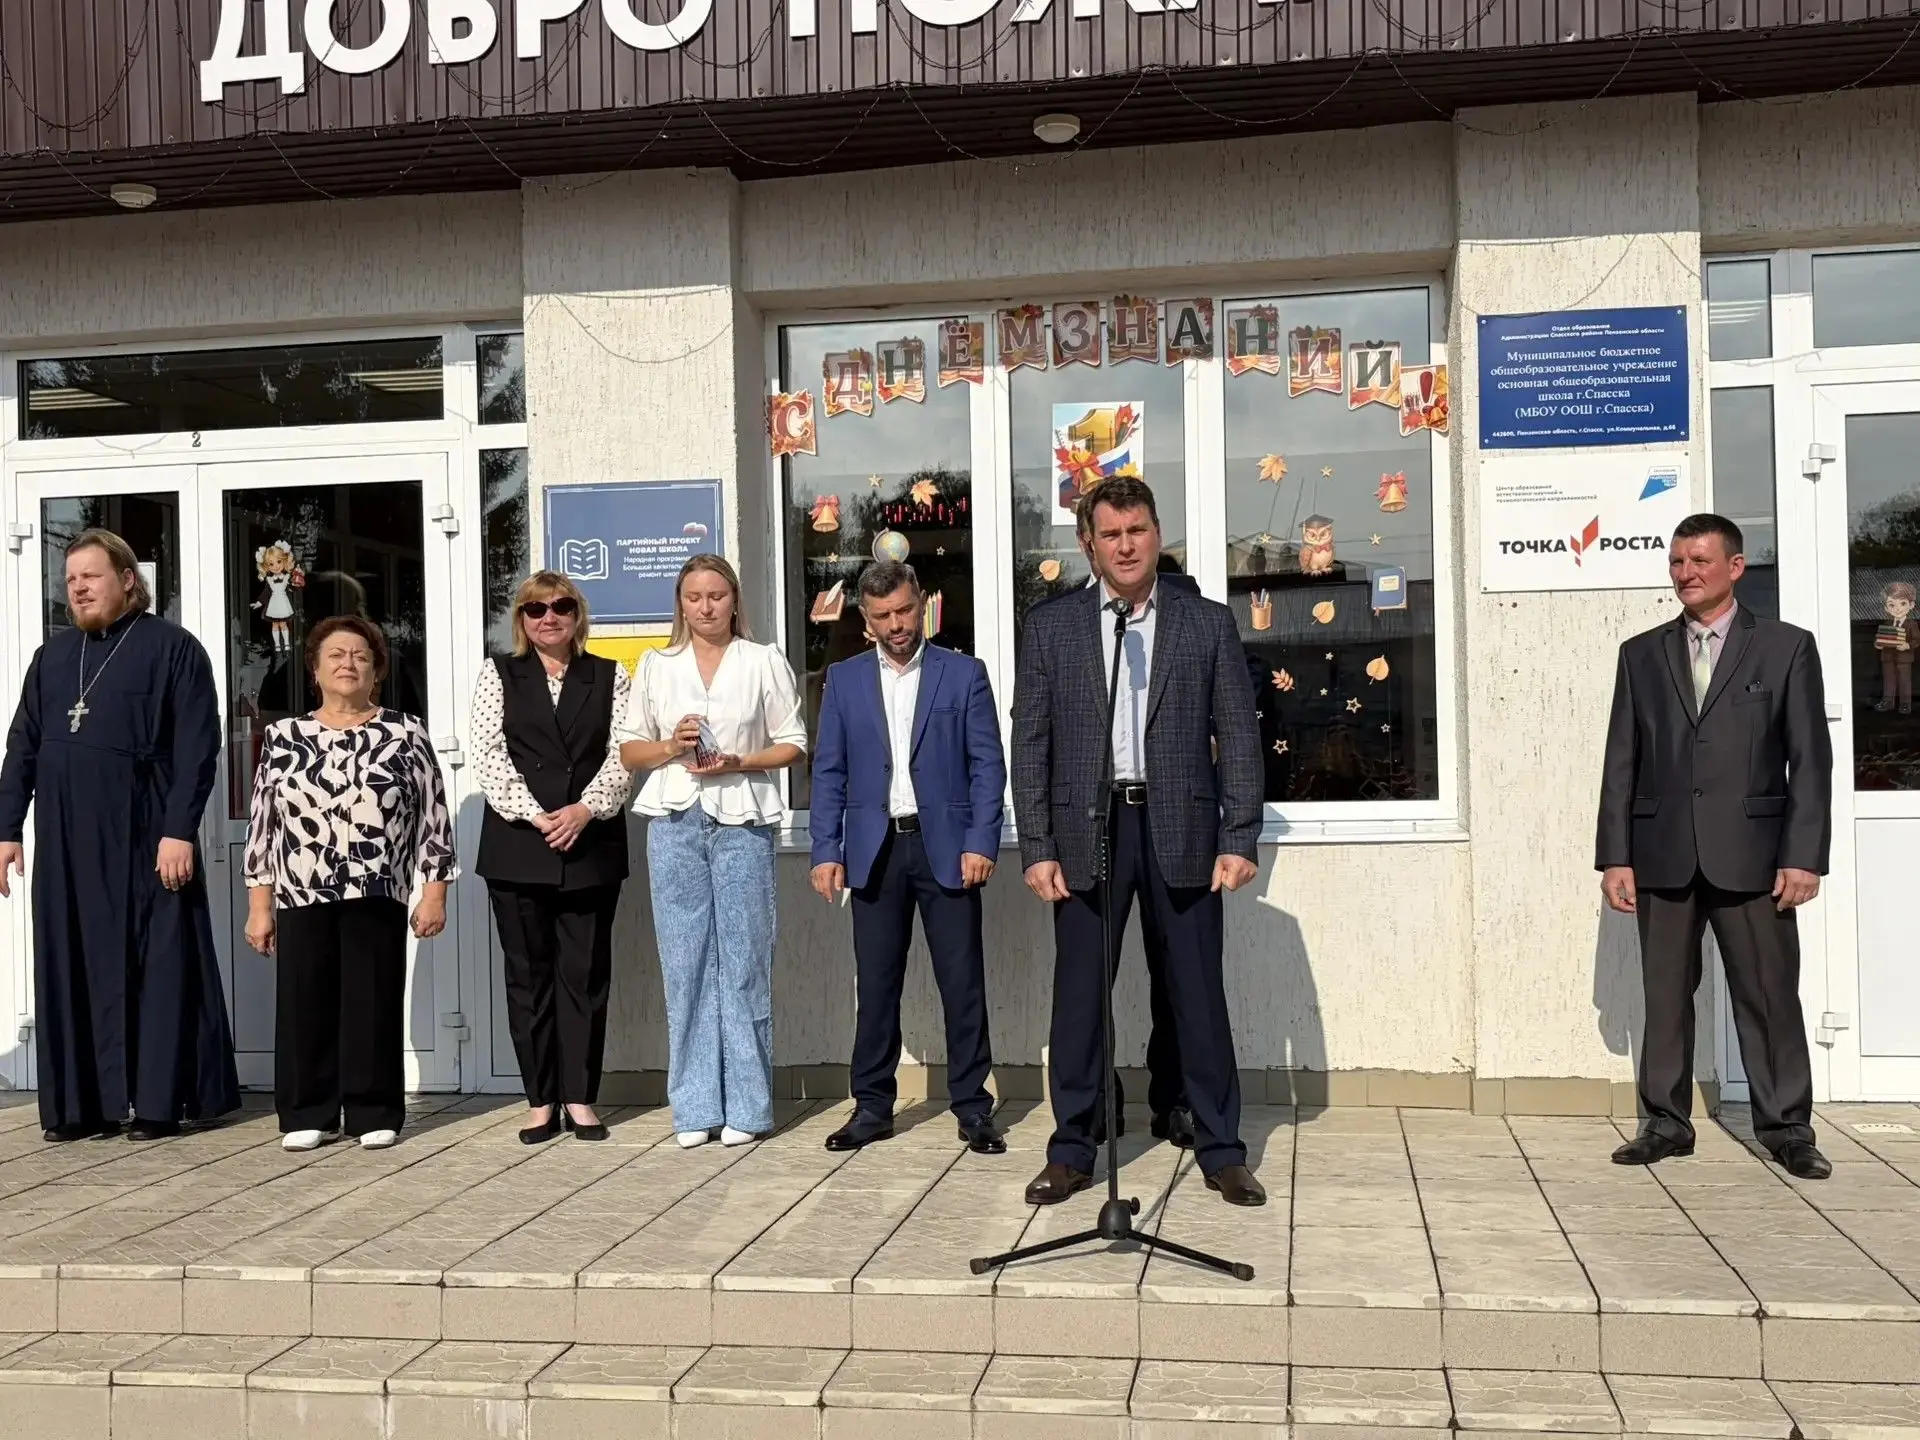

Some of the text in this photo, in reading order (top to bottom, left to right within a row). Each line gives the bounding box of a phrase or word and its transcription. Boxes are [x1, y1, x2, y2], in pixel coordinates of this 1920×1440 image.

[1507, 346, 1661, 363] Муниципальное бюджетное
[1490, 360, 1677, 377] общеобразовательное учреждение
[1498, 374, 1671, 390] основная общеобразовательная
[1538, 389, 1631, 401] школа г.Спасска
[1515, 402, 1655, 419] (МБОУ ООШ г.Спасска)
[192, 431, 201, 447] 2
[616, 537, 701, 546] ПАРТИЙНЫЙ ПРОЕКТ
[1499, 536, 1665, 555] ТОЧКА РОСТА
[629, 546, 657, 554] НОВАЯ
